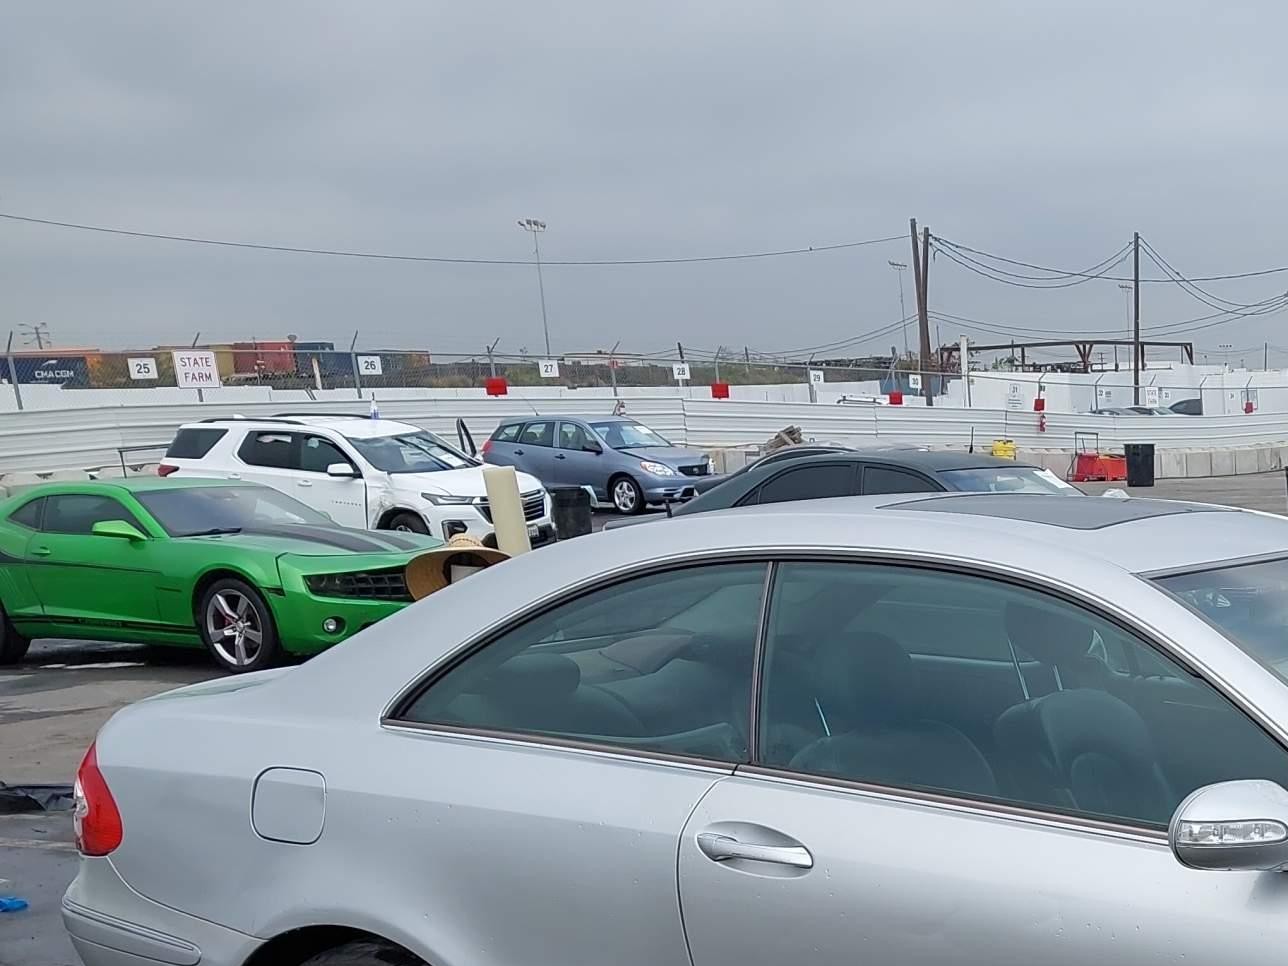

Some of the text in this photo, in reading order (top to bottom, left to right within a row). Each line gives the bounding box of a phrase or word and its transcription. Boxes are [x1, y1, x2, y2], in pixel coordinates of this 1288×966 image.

[179, 356, 211, 368] STATE
[363, 360, 377, 370] 26
[135, 363, 150, 374] 25
[544, 364, 554, 373] 27
[677, 366, 686, 376] 28
[184, 371, 212, 382] FARM
[813, 374, 821, 382] 29
